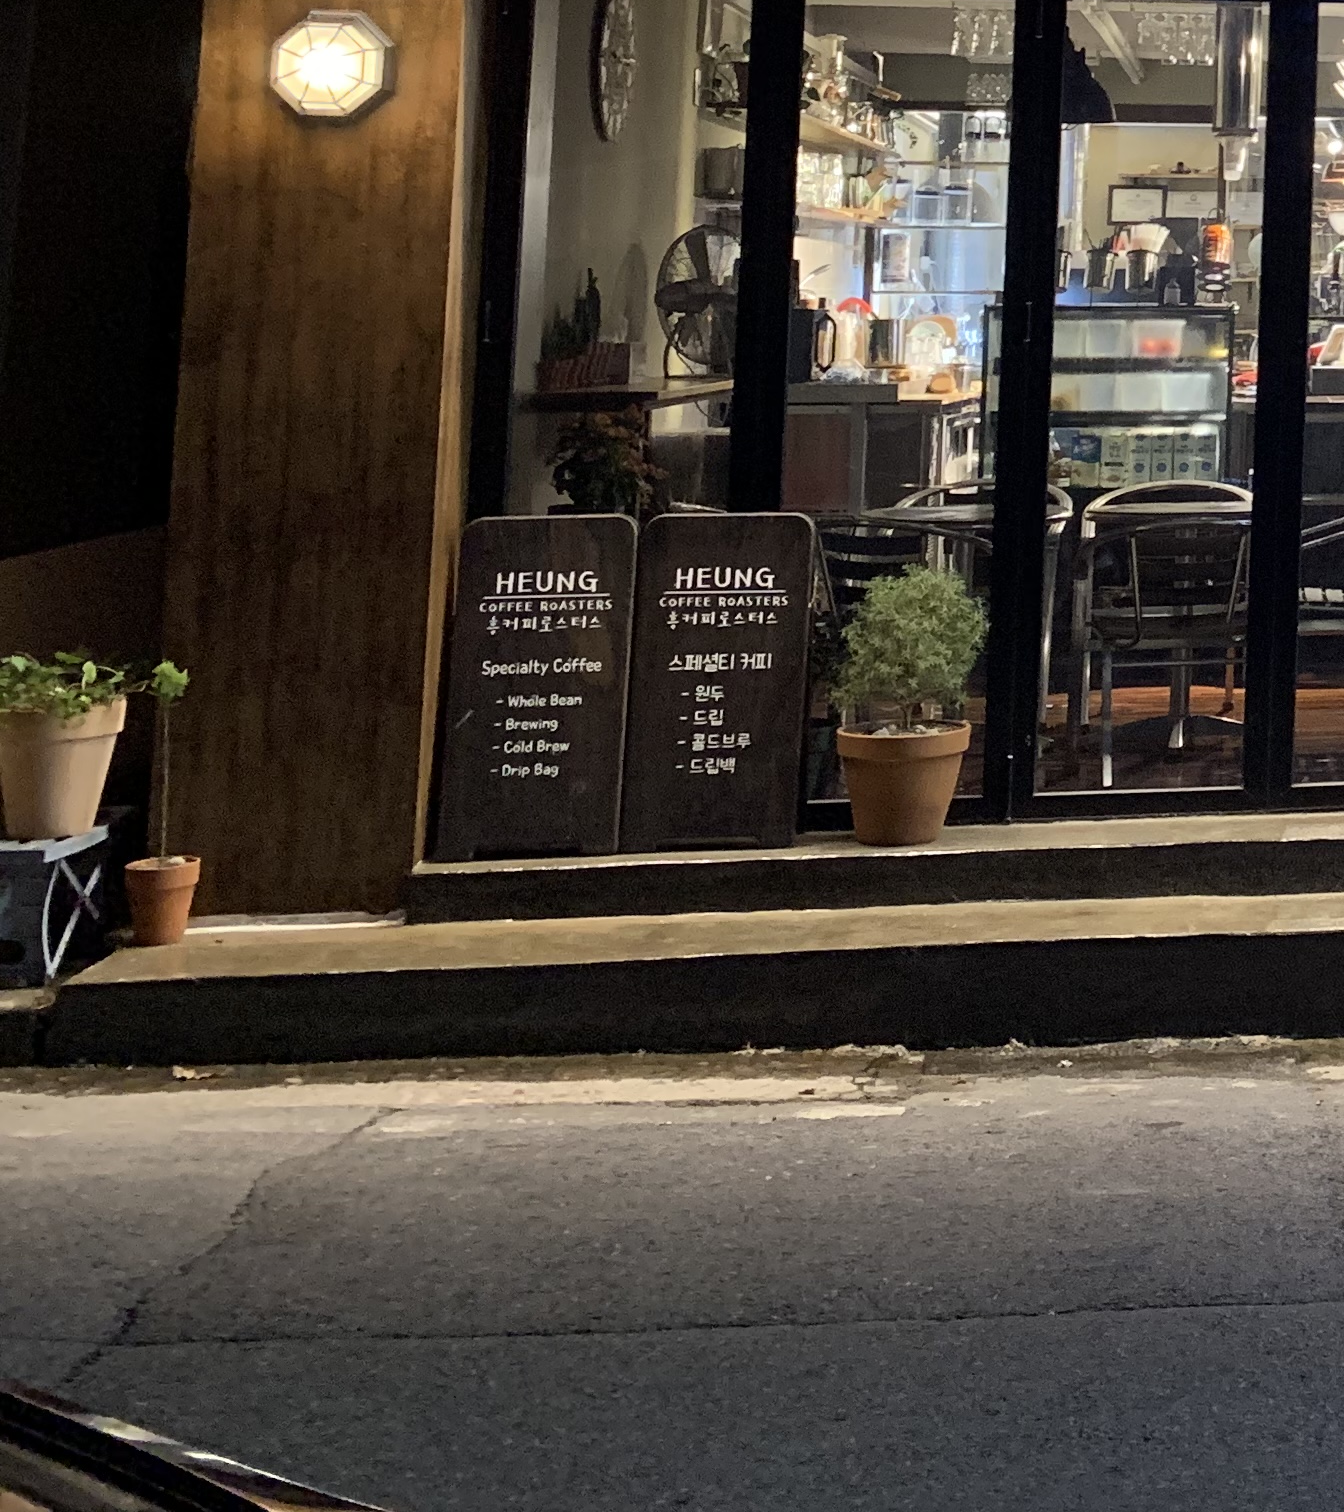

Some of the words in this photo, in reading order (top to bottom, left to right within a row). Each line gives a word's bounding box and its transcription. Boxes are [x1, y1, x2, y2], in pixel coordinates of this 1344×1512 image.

[496, 570, 599, 594] HEUNG
[675, 566, 776, 589] HEUNG
[479, 601, 533, 613] COFFEE
[539, 599, 613, 612] ROASTERS
[658, 596, 712, 608] COFFEE
[718, 595, 789, 607] ROASTERS
[486, 615, 602, 636] 흥커피로스터스
[666, 610, 779, 630] 흥커피로스터스
[481, 659, 549, 678] Specialty
[553, 657, 603, 674] Coffee
[667, 652, 736, 673] 스페셜티
[740, 652, 773, 670] 커피
[507, 694, 546, 708] Whole
[549, 693, 583, 707] Bean
[694, 685, 725, 703] 원두
[505, 718, 559, 732] Brewing
[692, 709, 724, 726] 드립
[503, 740, 534, 754] Cold
[536, 739, 571, 753] Brew
[691, 732, 752, 752] 콜드브루
[501, 764, 530, 778] Drip
[533, 763, 560, 778] Bag
[689, 757, 737, 775] 드립백
